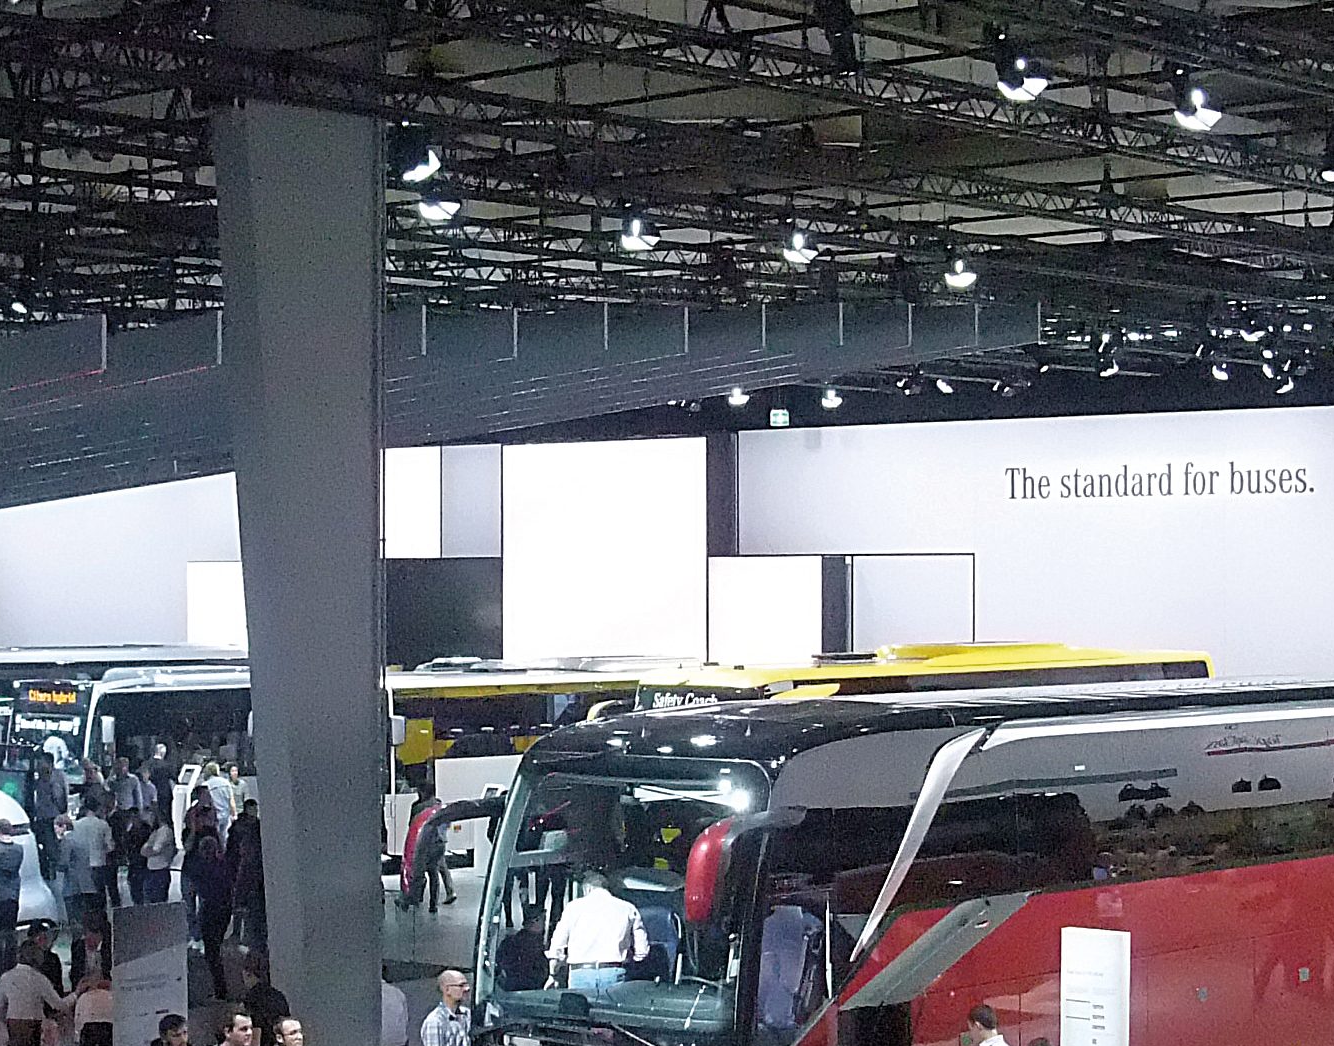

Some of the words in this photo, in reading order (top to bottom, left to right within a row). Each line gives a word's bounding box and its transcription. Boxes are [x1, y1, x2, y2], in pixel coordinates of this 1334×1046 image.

[1004, 467, 1051, 499] The
[1060, 463, 1174, 498] standard
[1183, 462, 1220, 496] for
[1228, 461, 1316, 495] buses.
